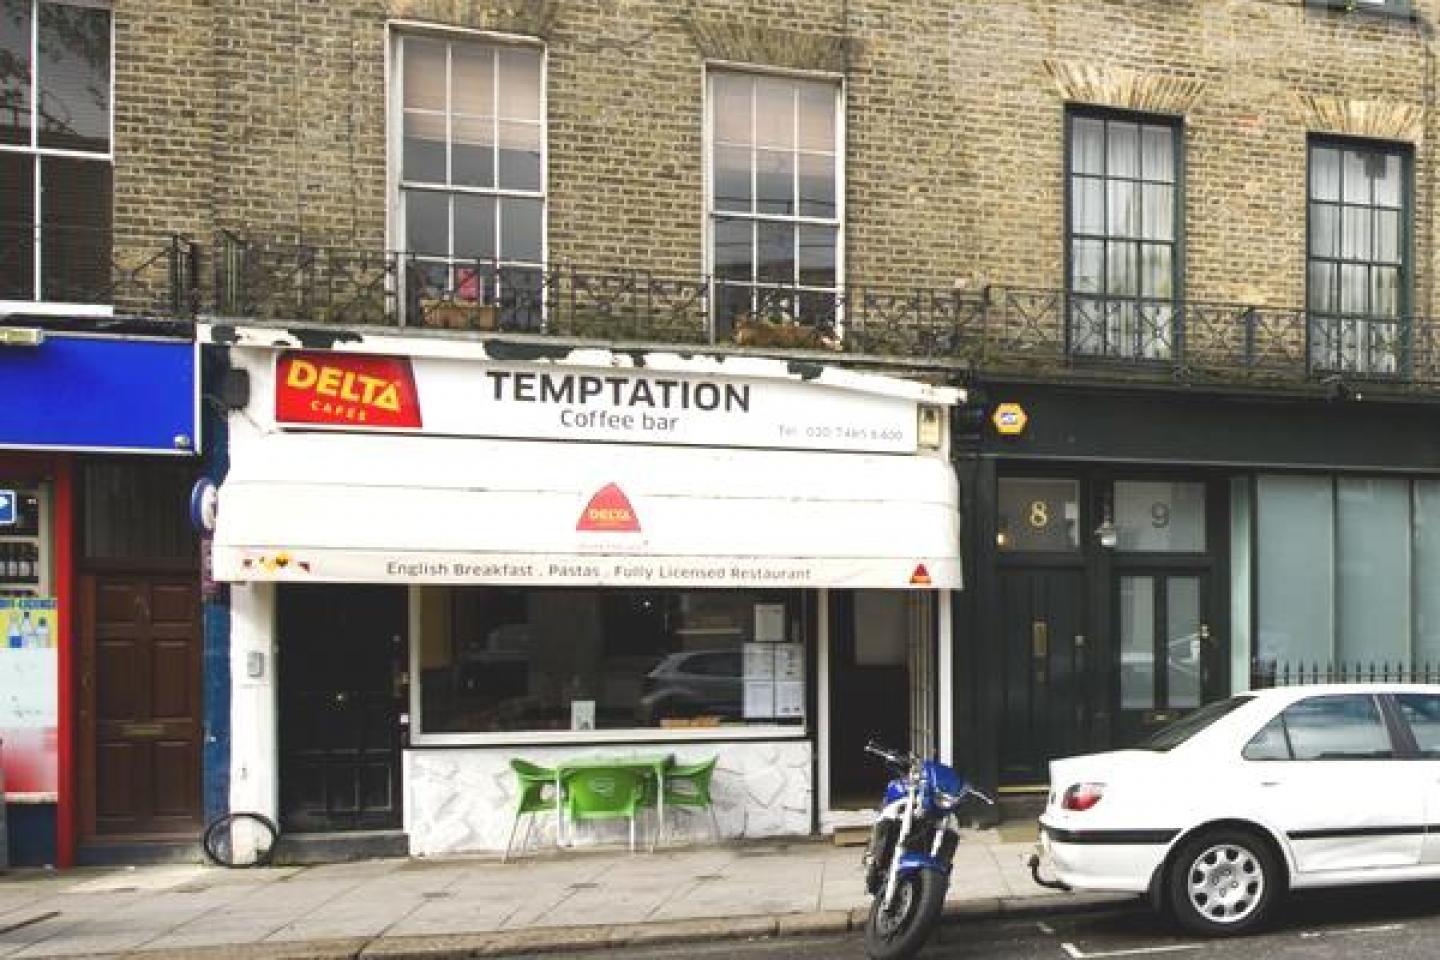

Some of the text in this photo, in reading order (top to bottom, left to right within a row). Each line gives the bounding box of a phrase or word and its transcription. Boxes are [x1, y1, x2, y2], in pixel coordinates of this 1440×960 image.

[287, 359, 401, 411] DELTA
[486, 371, 750, 413] TEMPTATION
[560, 409, 679, 432] Coffee bar
[588, 507, 633, 521] DELTA
[1029, 501, 1048, 527] 8
[1151, 501, 1169, 528] 9
[386, 561, 812, 581] English Breakfast Pastas Fully Licensed Restaurant
